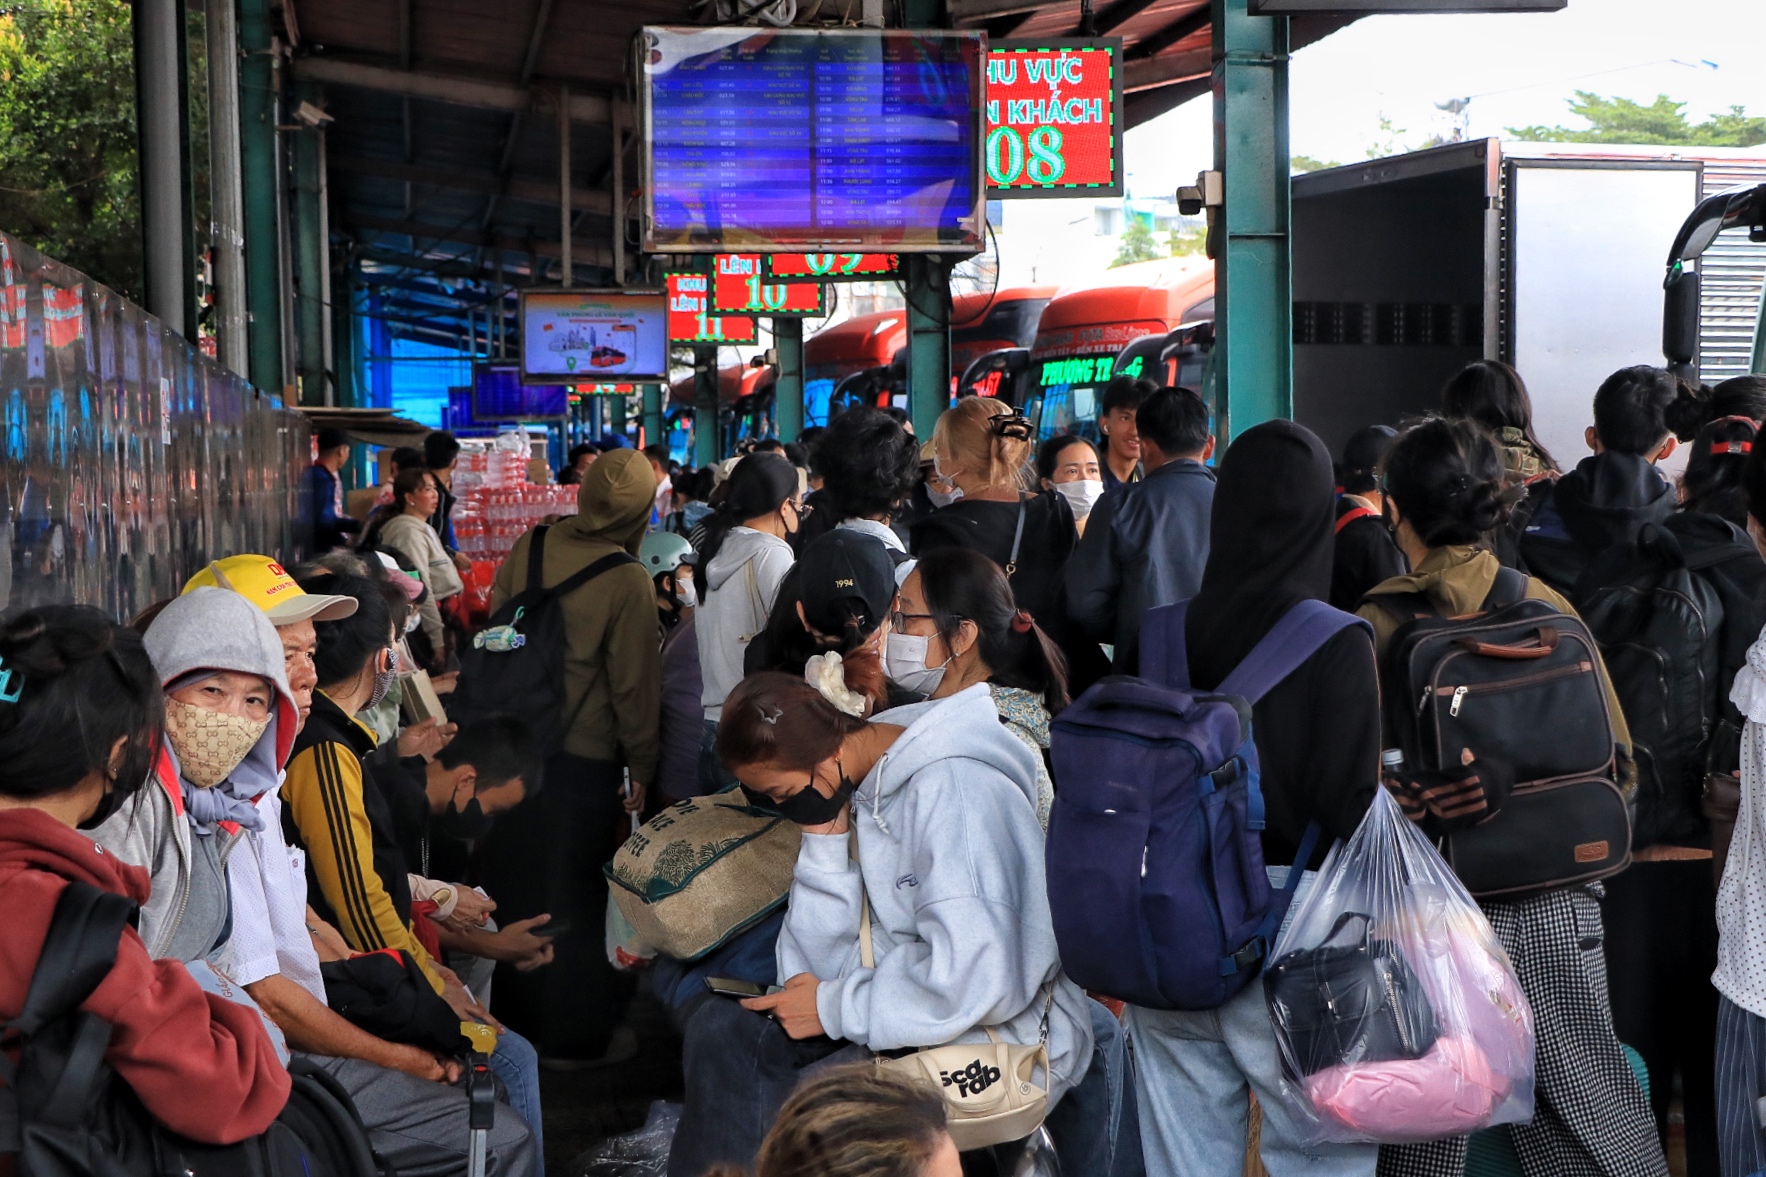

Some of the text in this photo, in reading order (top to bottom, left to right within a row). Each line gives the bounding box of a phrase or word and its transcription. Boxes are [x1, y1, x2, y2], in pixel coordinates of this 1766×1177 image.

[1024, 52, 1083, 90] VỰC
[1007, 90, 1103, 125] KHÁCH
[987, 125, 1066, 184] 08
[720, 254, 753, 275] LÊN
[671, 294, 699, 312] LÊN
[746, 274, 788, 310] 10
[695, 312, 725, 340] 11
[1095, 356, 1143, 382] TRG
[834, 578, 854, 589] 1994
